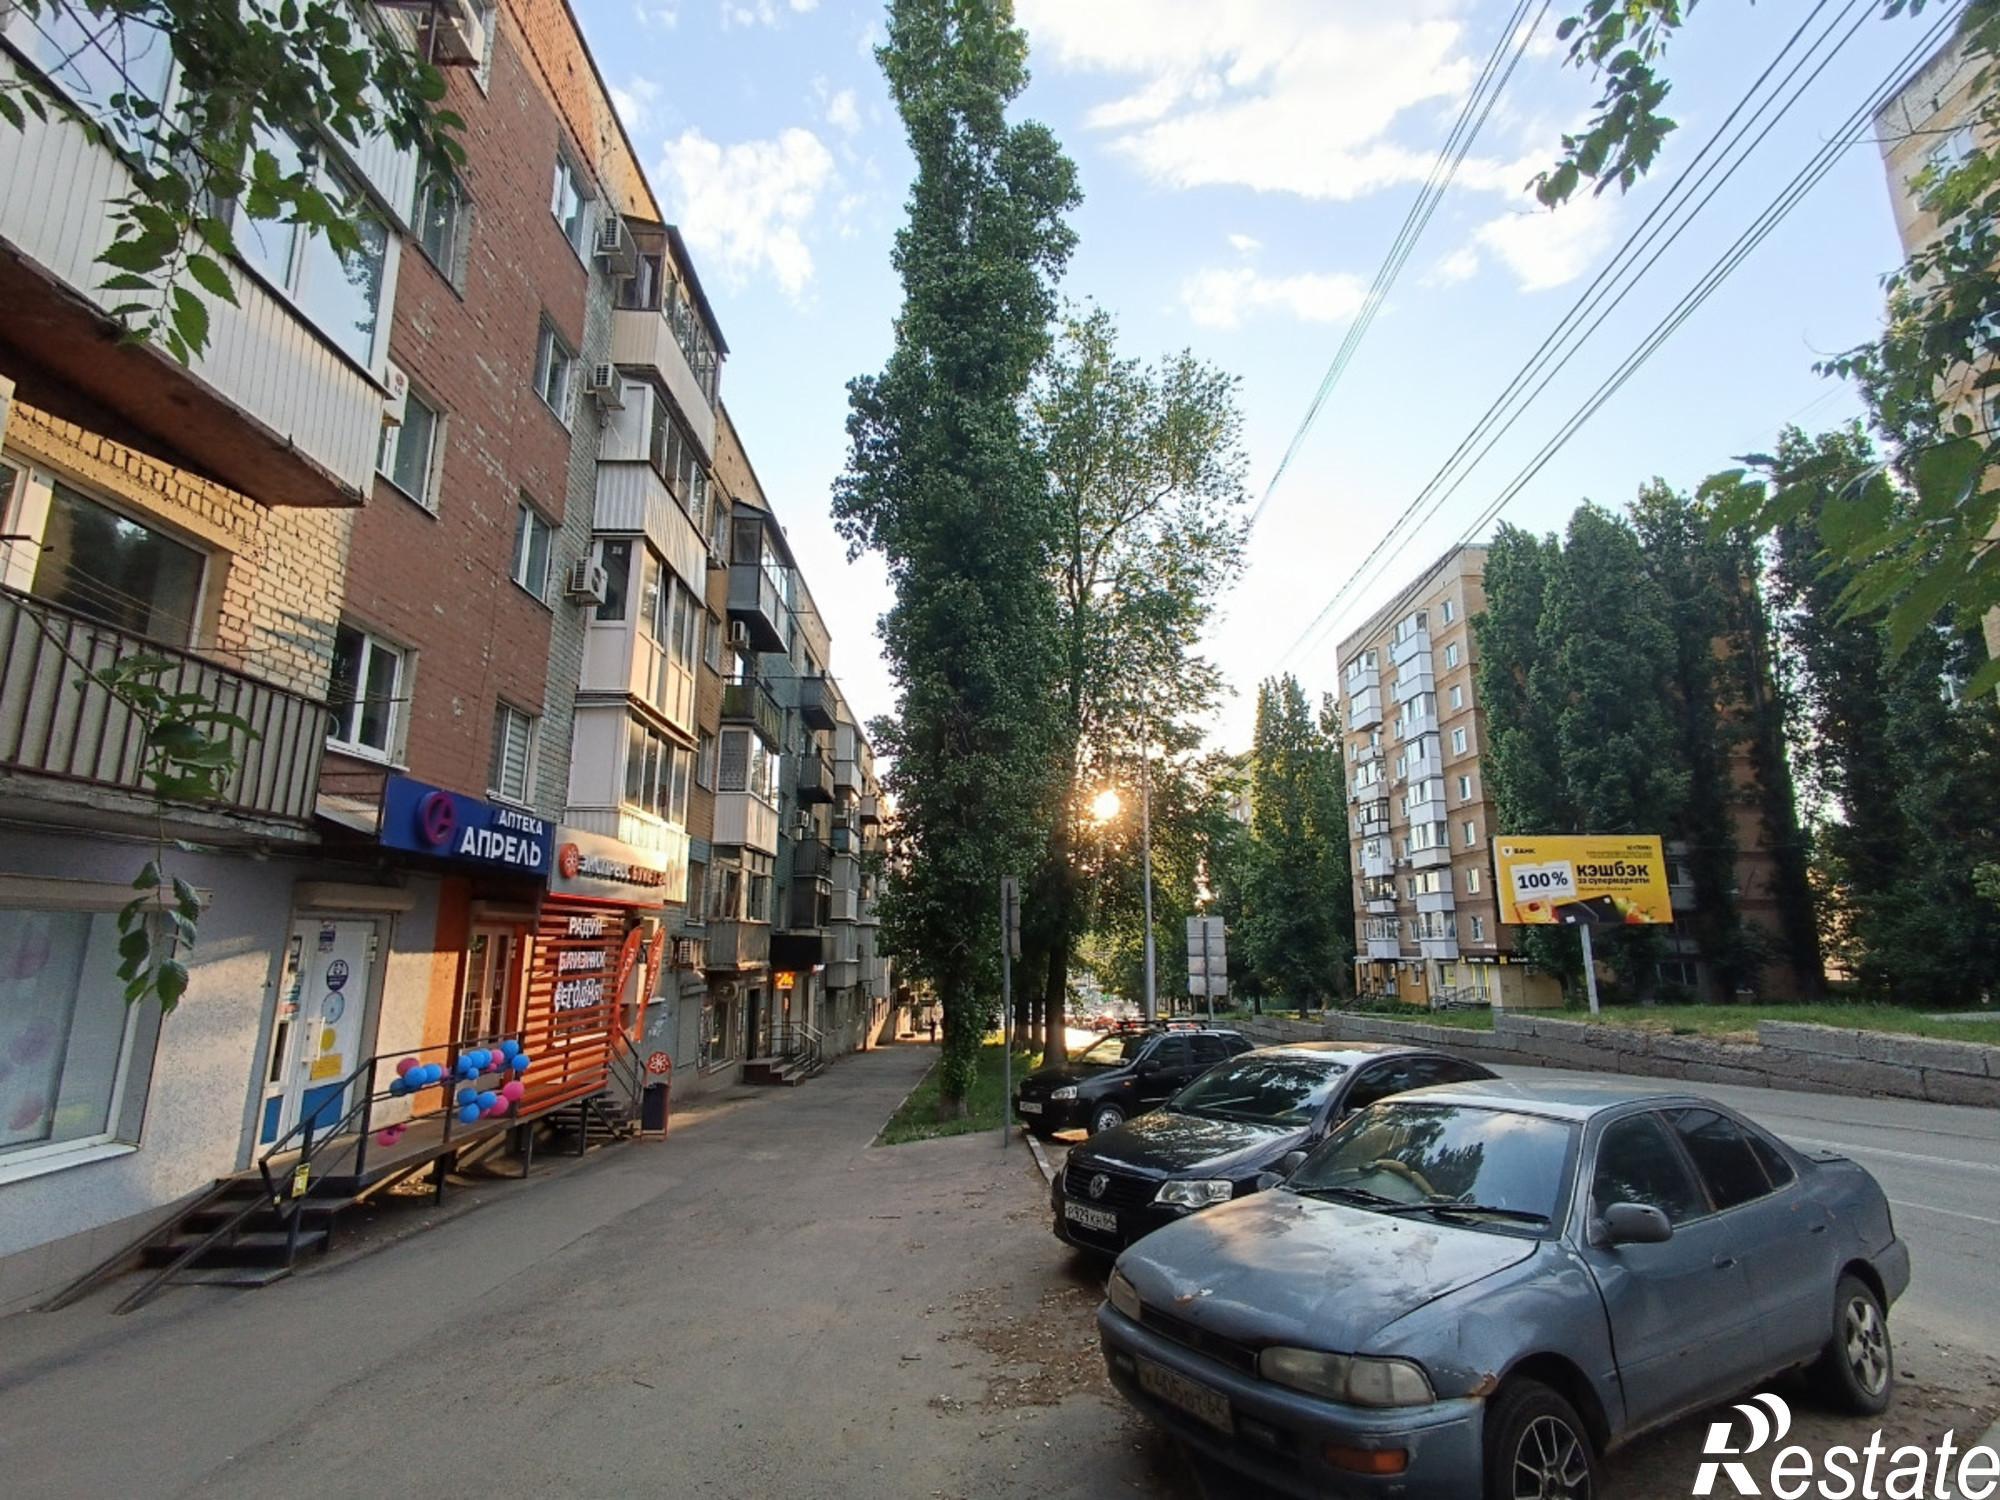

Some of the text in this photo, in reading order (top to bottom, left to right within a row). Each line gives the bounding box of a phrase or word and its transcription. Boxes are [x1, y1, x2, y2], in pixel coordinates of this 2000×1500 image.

[498, 809, 543, 836] АПТЕКА
[459, 825, 542, 867] АПРЕЛЬ
[1577, 860, 1649, 877] кэшбэк
[1518, 871, 1568, 889] 100%
